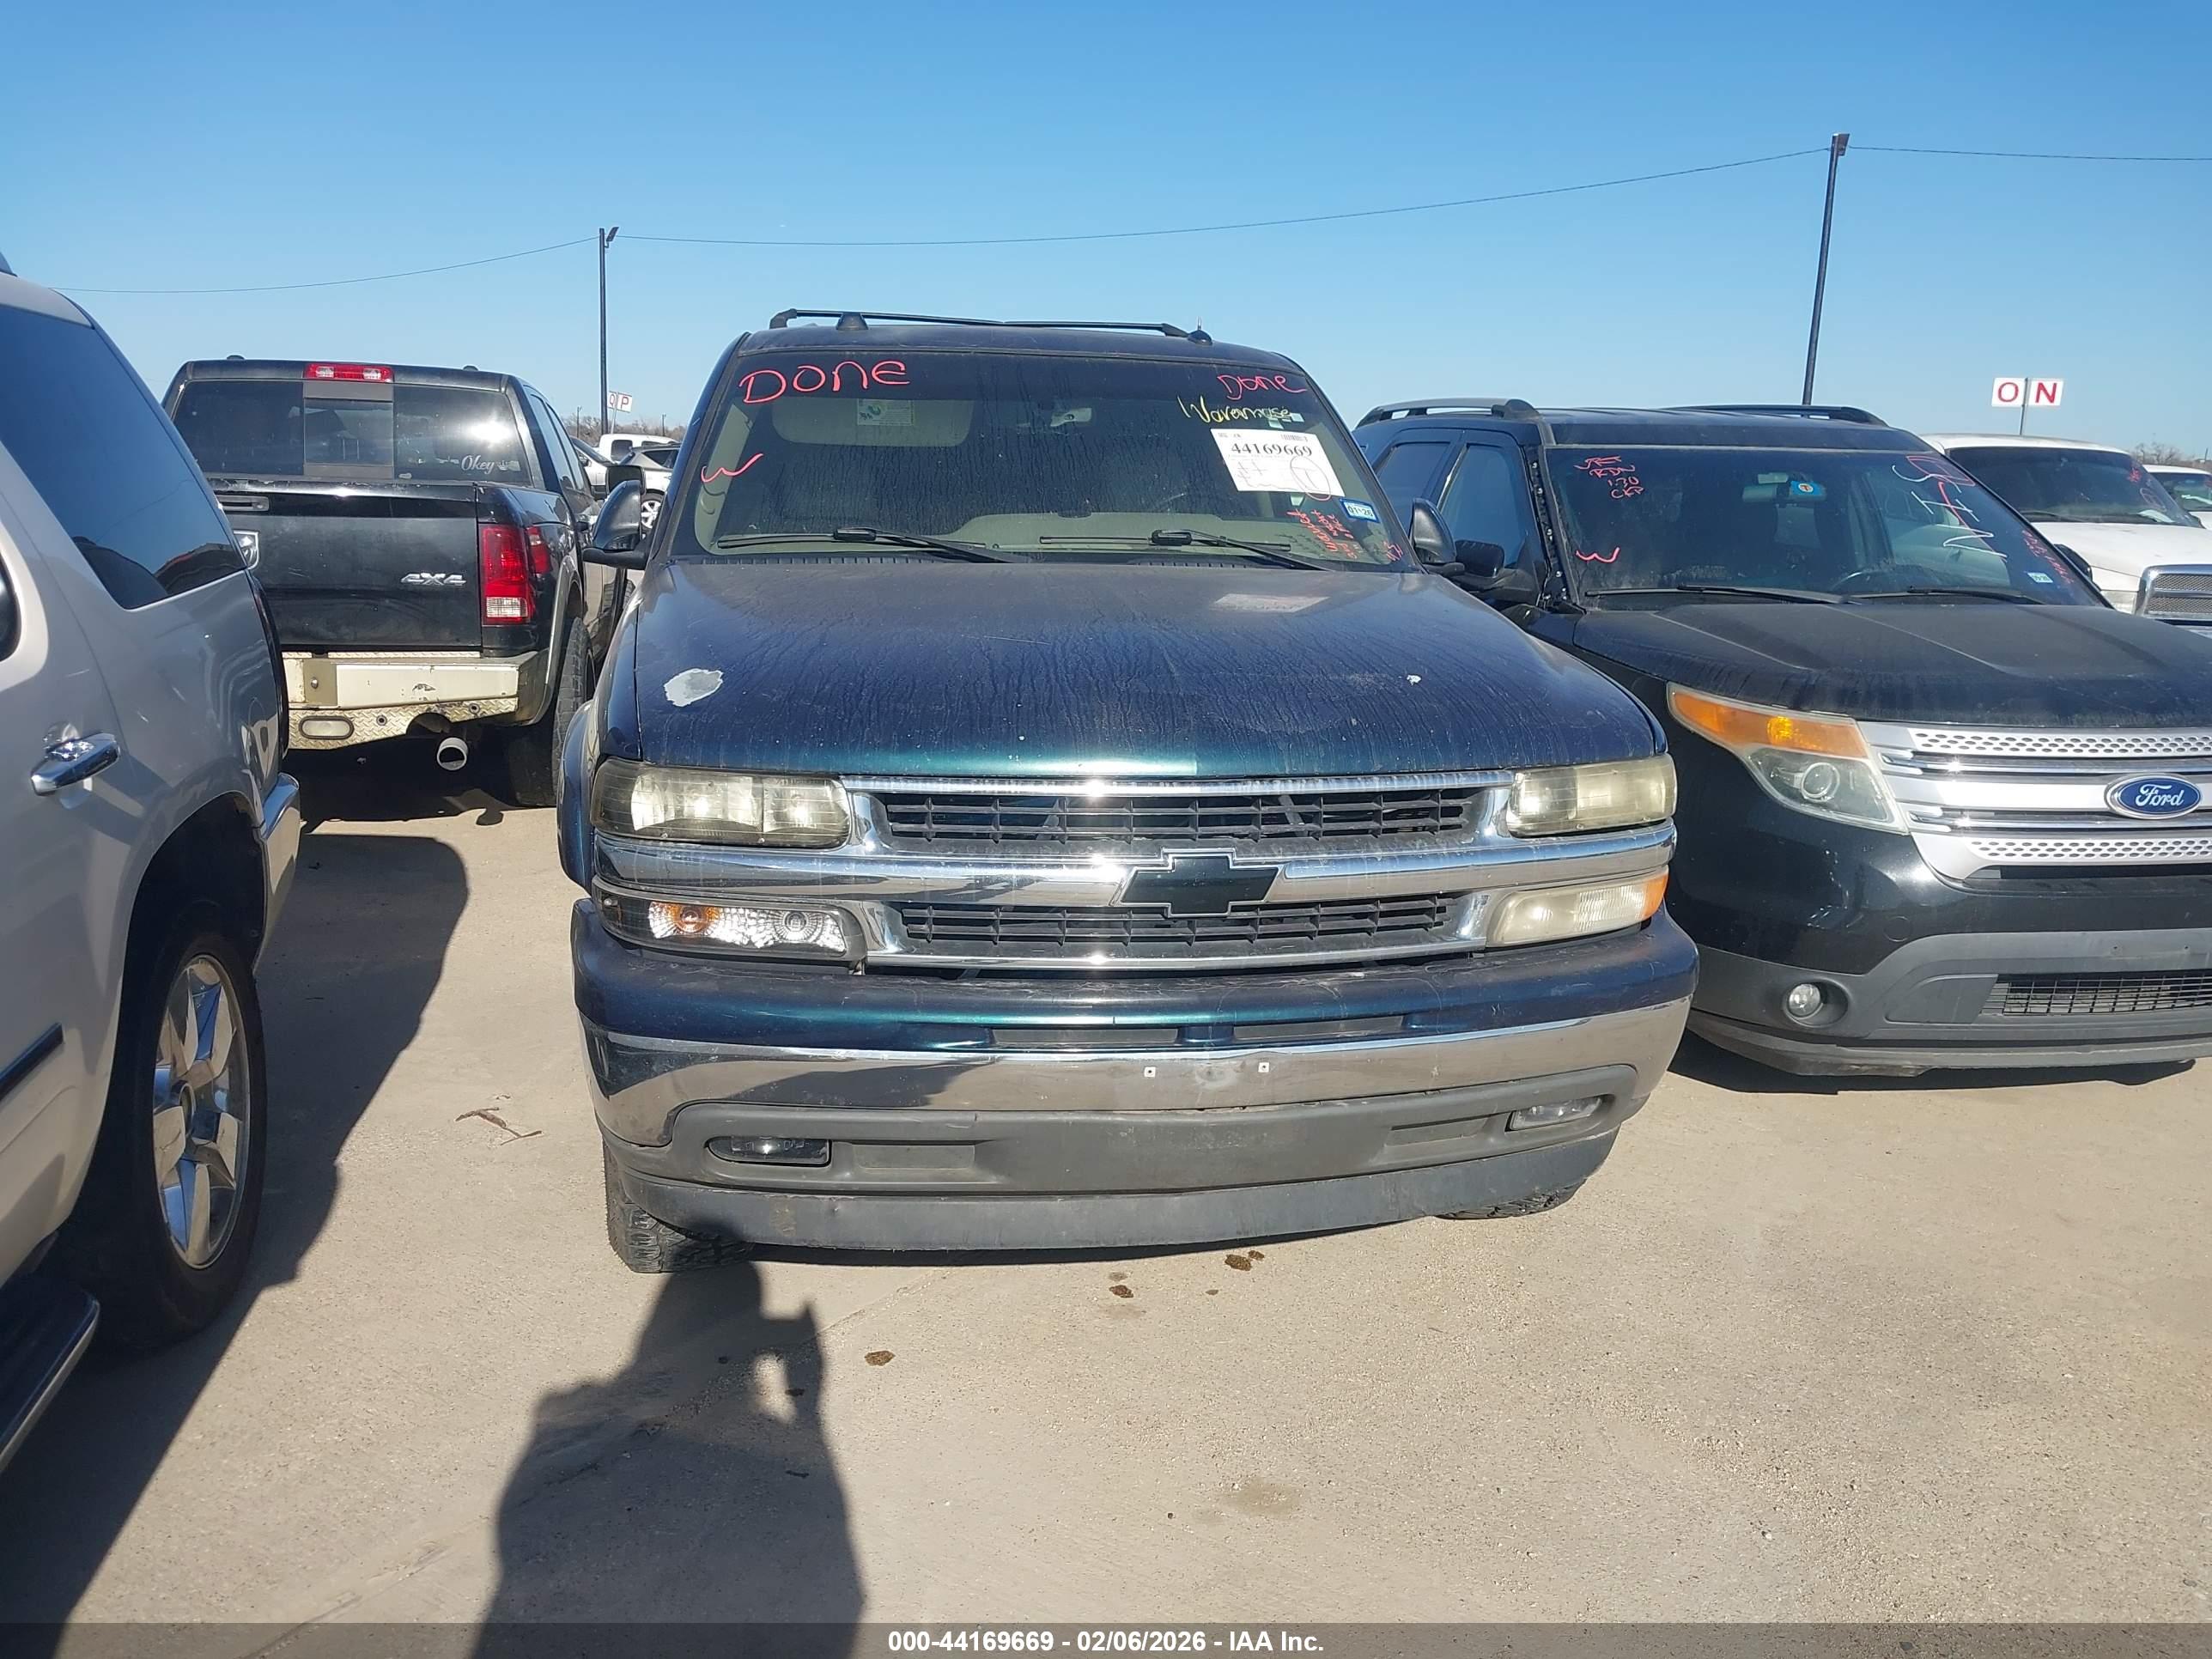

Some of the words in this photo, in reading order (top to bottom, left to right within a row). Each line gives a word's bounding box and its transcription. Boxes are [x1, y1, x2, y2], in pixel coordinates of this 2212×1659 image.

[620, 396, 629, 410] P
[1997, 381, 2019, 403] O
[2035, 382, 2057, 404] N
[1231, 442, 1313, 458] 44169669
[460, 454, 495, 475] Okey
[2135, 783, 2185, 807] Ford
